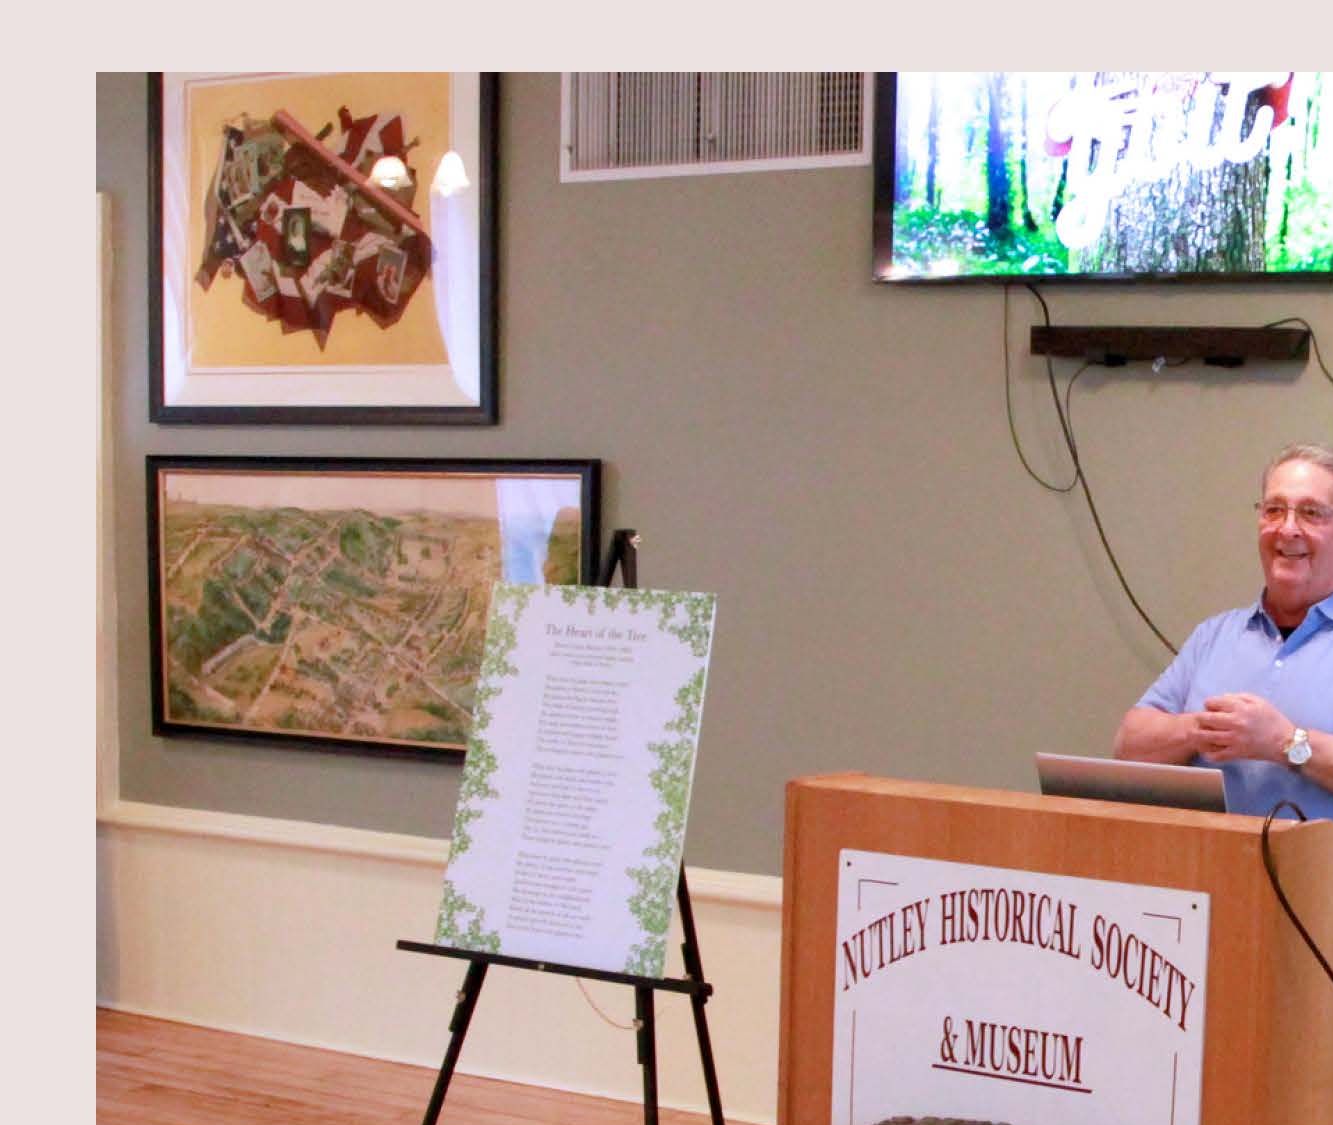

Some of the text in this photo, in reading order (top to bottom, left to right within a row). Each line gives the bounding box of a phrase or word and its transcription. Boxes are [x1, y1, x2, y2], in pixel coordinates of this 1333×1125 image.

[545, 623, 648, 641] The Heart of the Tree
[842, 888, 1195, 1032] NUTLEY HISTORICAL SOCIETY
[940, 1016, 1083, 1083] & MUSEUM
